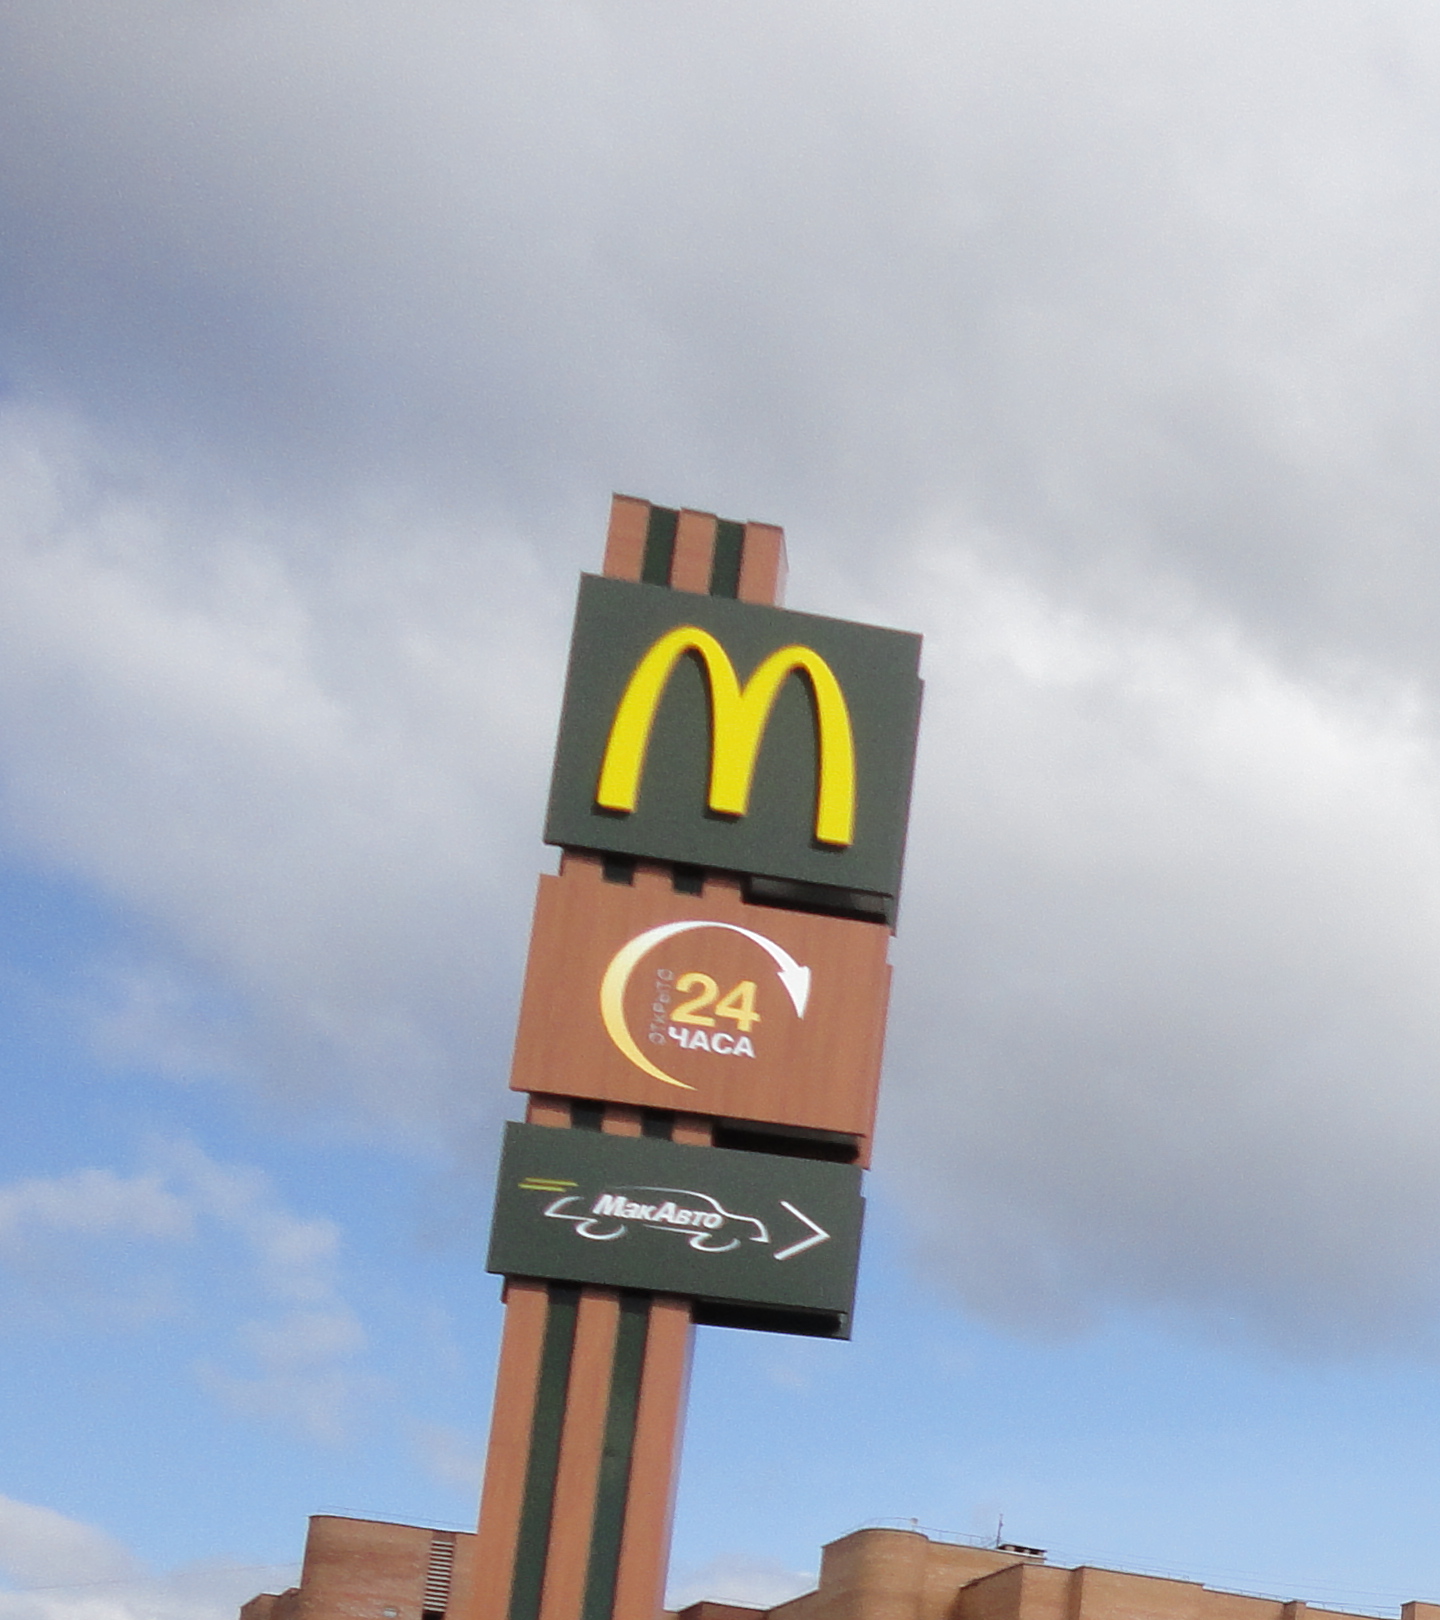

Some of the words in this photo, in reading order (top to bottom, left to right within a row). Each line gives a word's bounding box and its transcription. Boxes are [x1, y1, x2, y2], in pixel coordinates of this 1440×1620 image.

[647, 968, 676, 1046] ОТКРЫТО
[669, 971, 762, 1033] 24
[667, 1025, 757, 1059] ЧАСА
[592, 1193, 725, 1230] МакАвто
